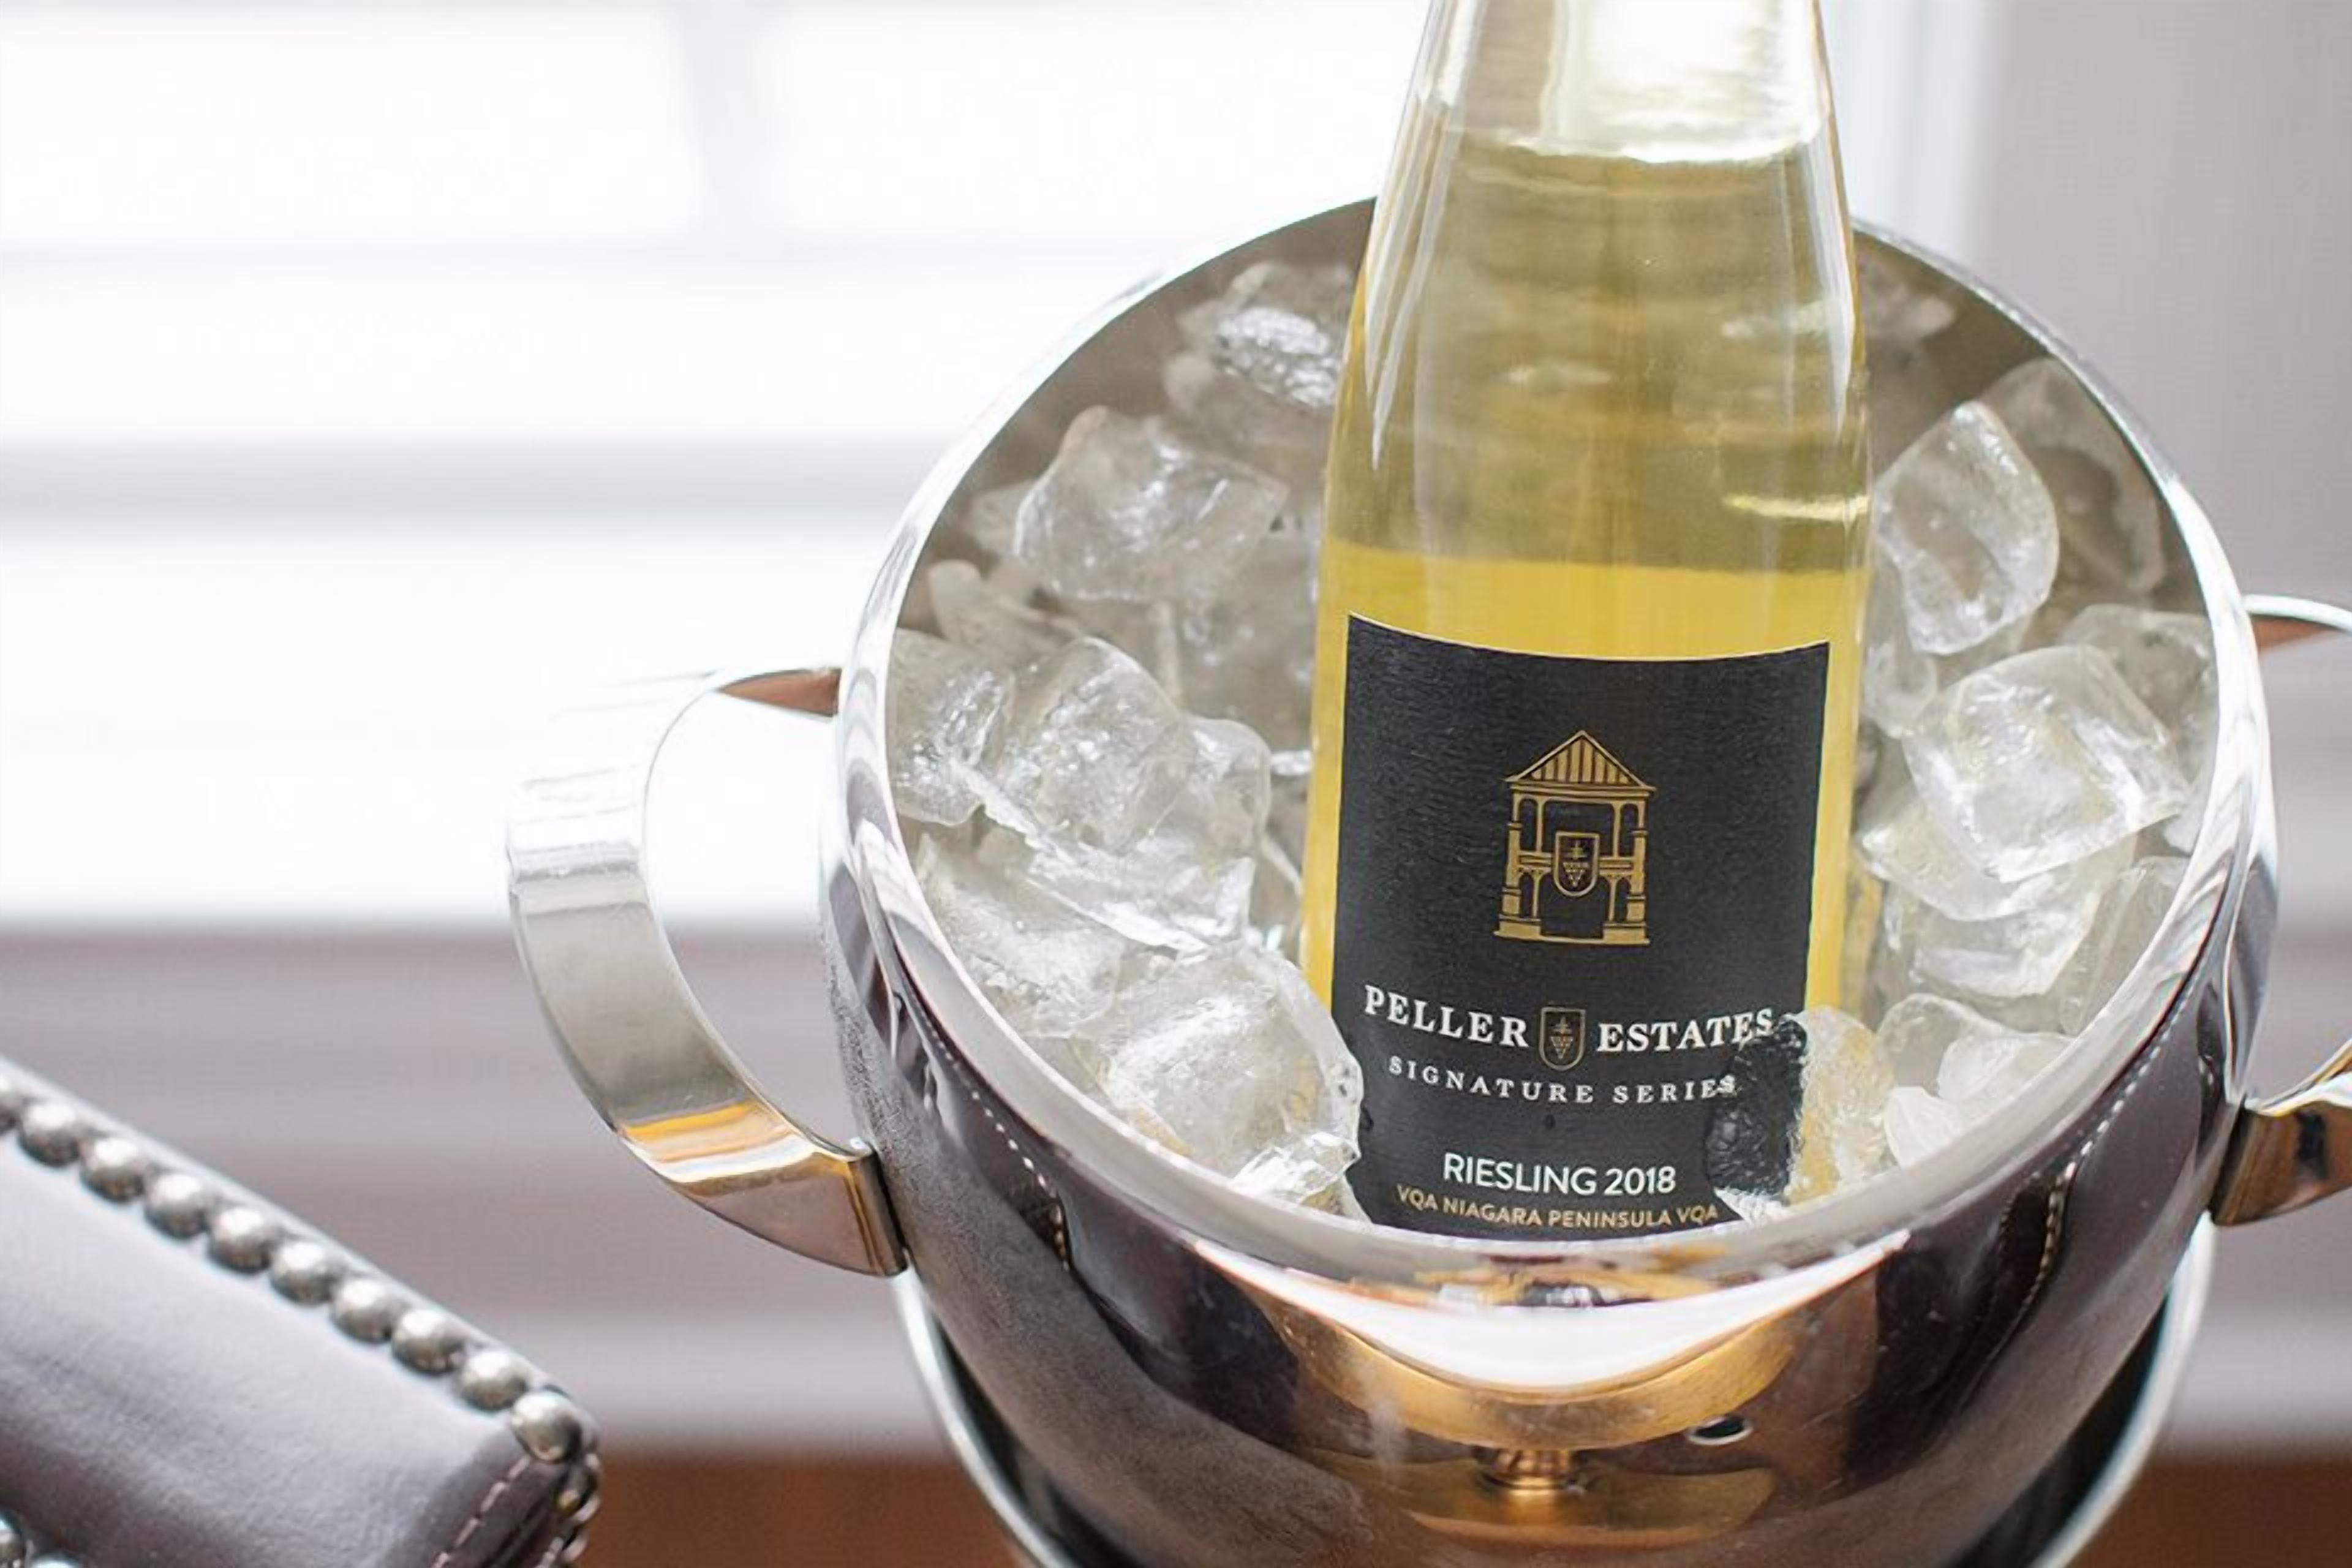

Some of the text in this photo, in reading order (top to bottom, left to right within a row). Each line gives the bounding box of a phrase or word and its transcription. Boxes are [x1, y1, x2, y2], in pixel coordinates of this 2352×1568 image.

[1364, 984, 1773, 1052] PELLER ESTATES
[1388, 1055, 1736, 1103] SIGNATURE SERIES
[1443, 1152, 1677, 1196] RIESLING 2018
[1396, 1184, 1719, 1228] VQA NIAGARA PENINSULA VQA
